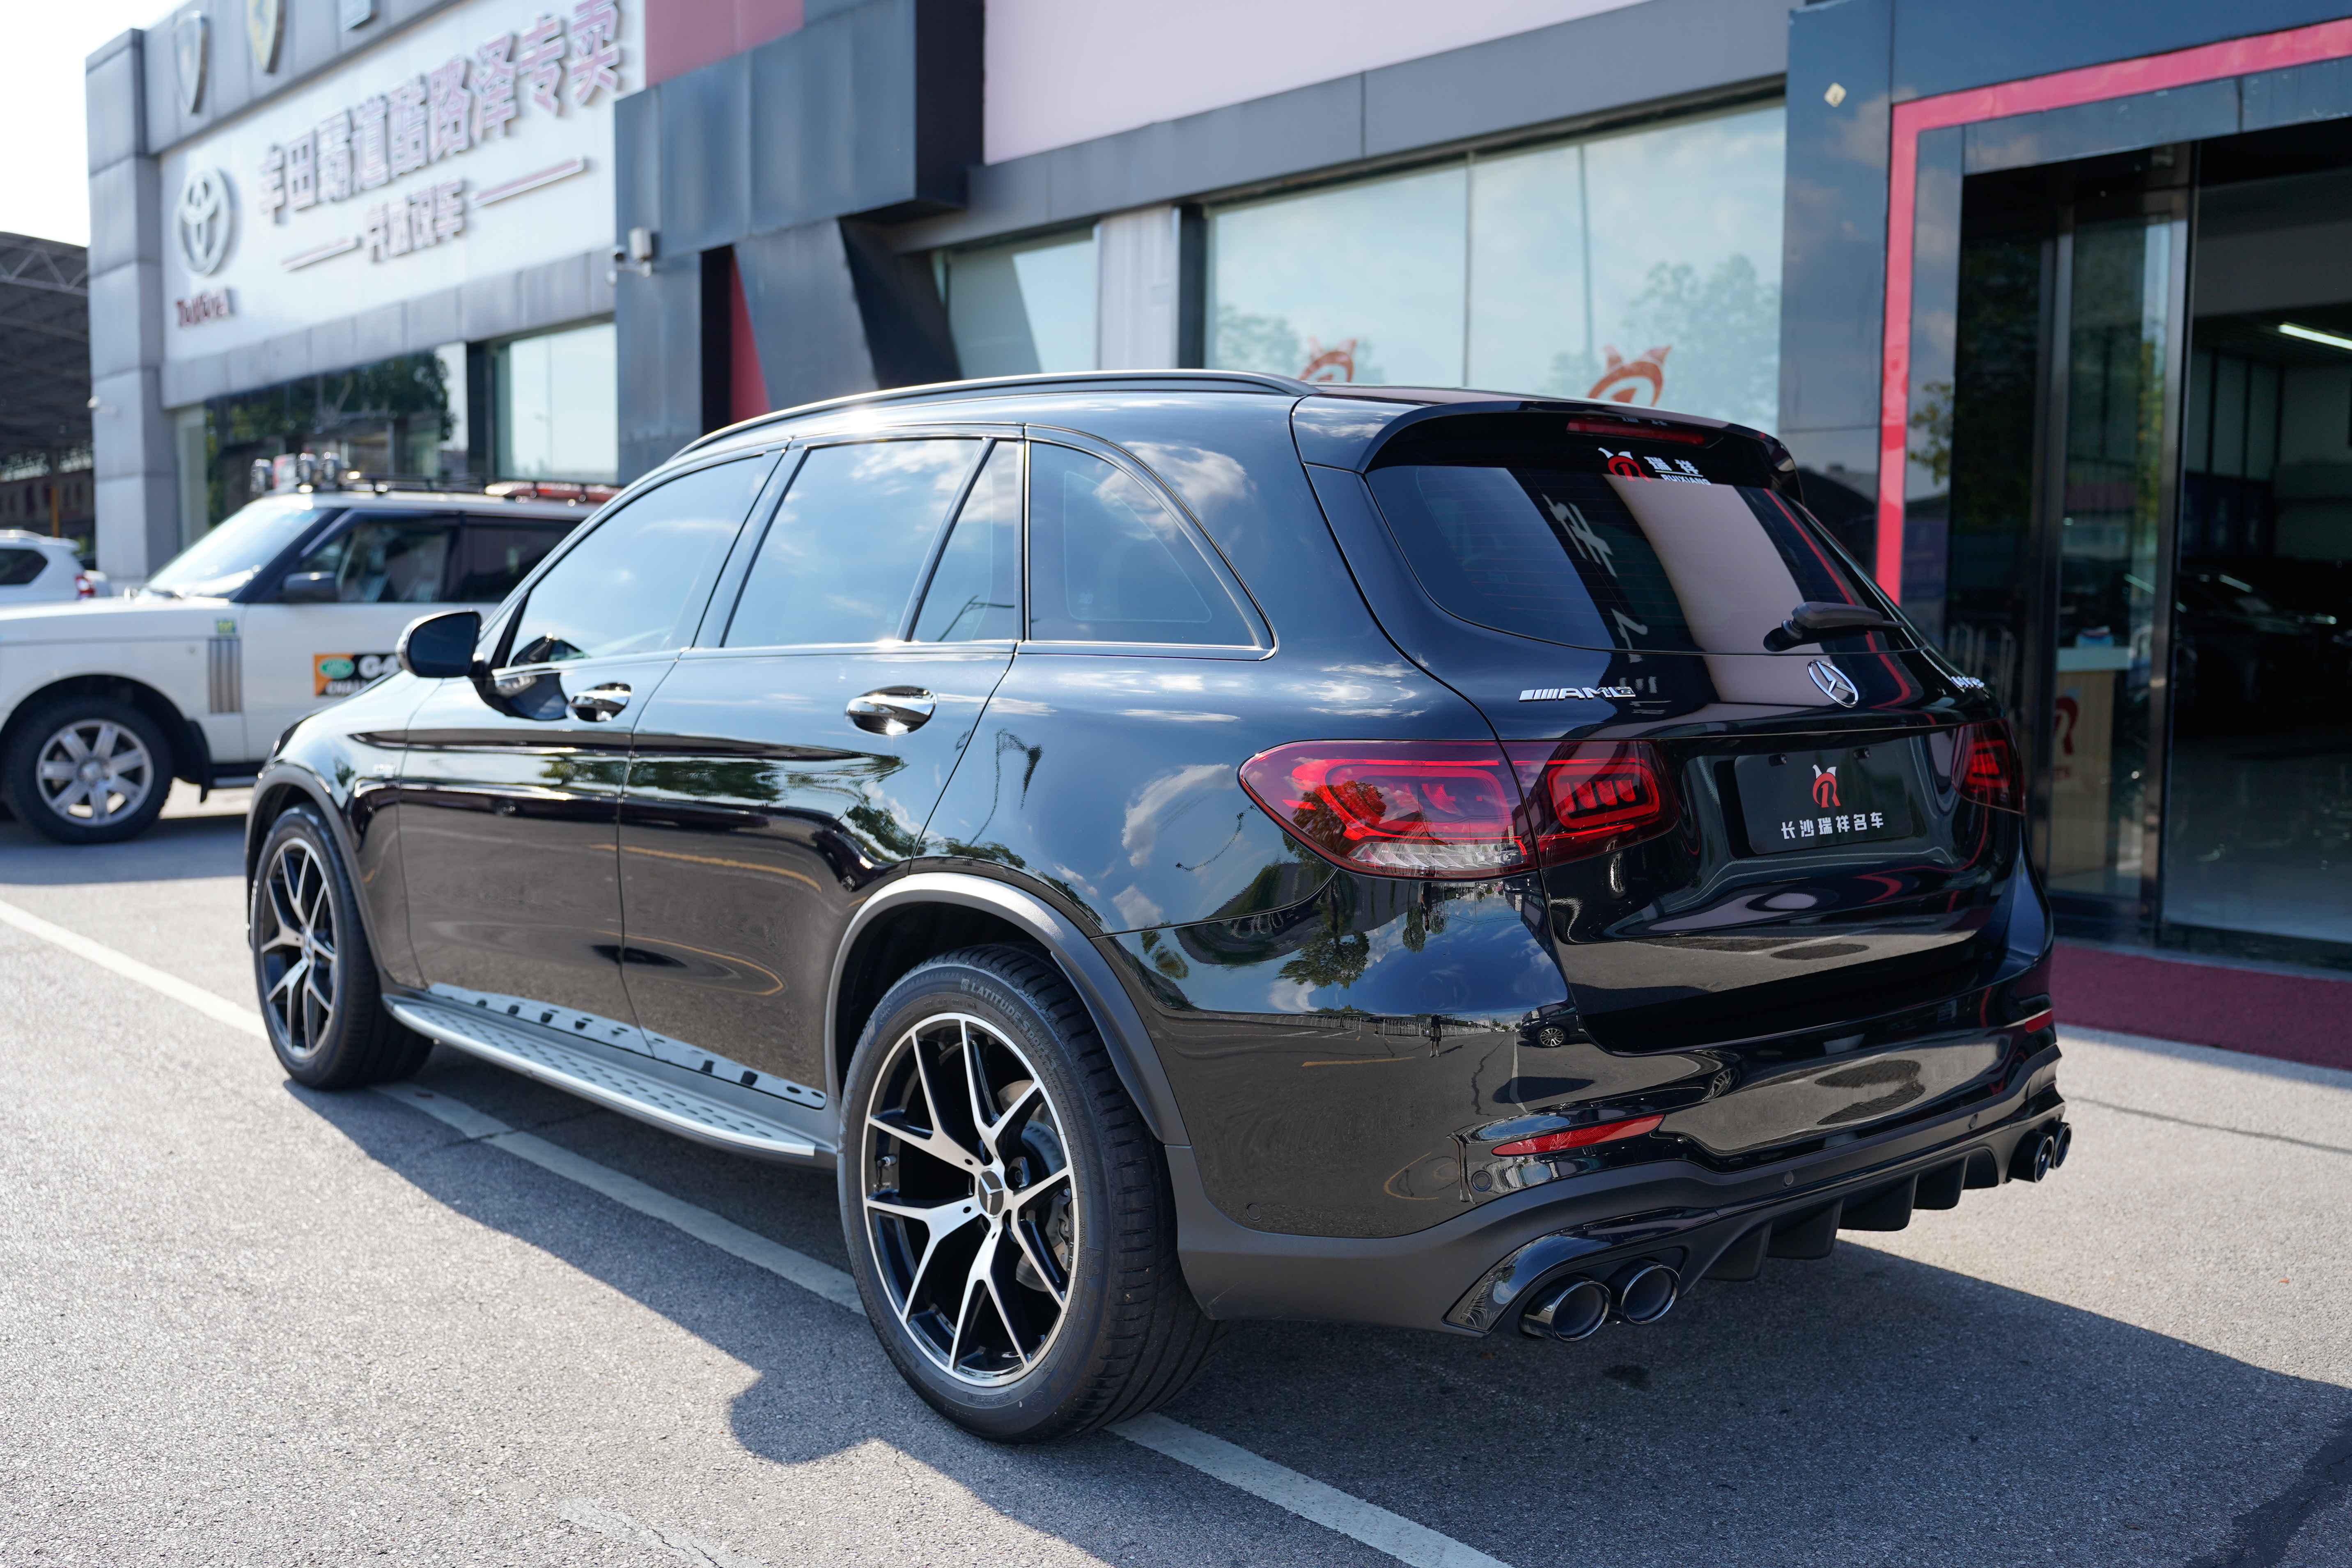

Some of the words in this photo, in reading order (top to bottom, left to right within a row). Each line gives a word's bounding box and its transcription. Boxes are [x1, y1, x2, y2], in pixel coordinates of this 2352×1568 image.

[257, 0, 620, 224] 丰田霸道酷路泽专卖
[1643, 456, 1699, 475] 瑞祥
[1660, 474, 1711, 486] RUIXIANG
[1558, 686, 1636, 700] AMG
[1781, 812, 1884, 839] 长沙瑞祥名车
[970, 982, 1021, 1022] LATITUDE
[1047, 1058, 1058, 1071] 3
[1047, 1282, 1099, 1397] MICHELIN
